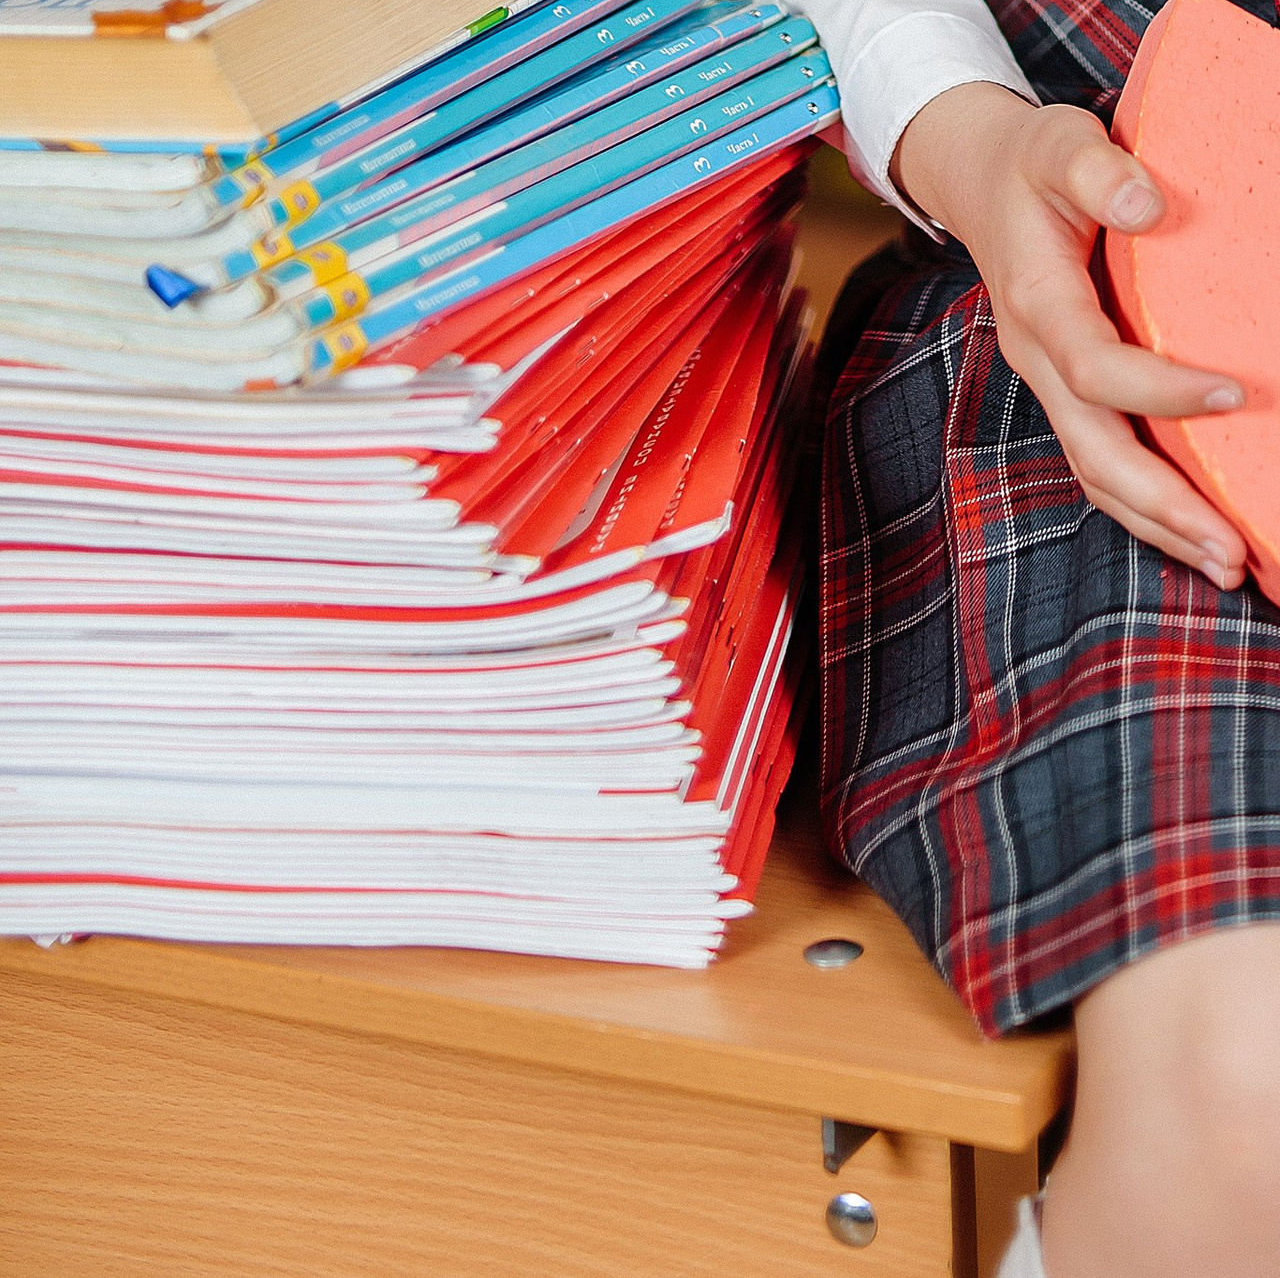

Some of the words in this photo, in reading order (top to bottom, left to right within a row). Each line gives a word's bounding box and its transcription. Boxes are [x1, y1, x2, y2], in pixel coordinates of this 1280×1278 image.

[553, 5, 571, 19] 3
[597, 28, 615, 44] 3
[625, 11, 647, 27] Часть
[626, 61, 646, 75] 3
[659, 41, 686, 57] Часть
[665, 84, 685, 98] 3
[698, 66, 724, 82] Часть
[690, 119, 708, 135] 3
[721, 100, 747, 117] Часть
[694, 157, 712, 173] 3
[726, 138, 752, 155] Часть
